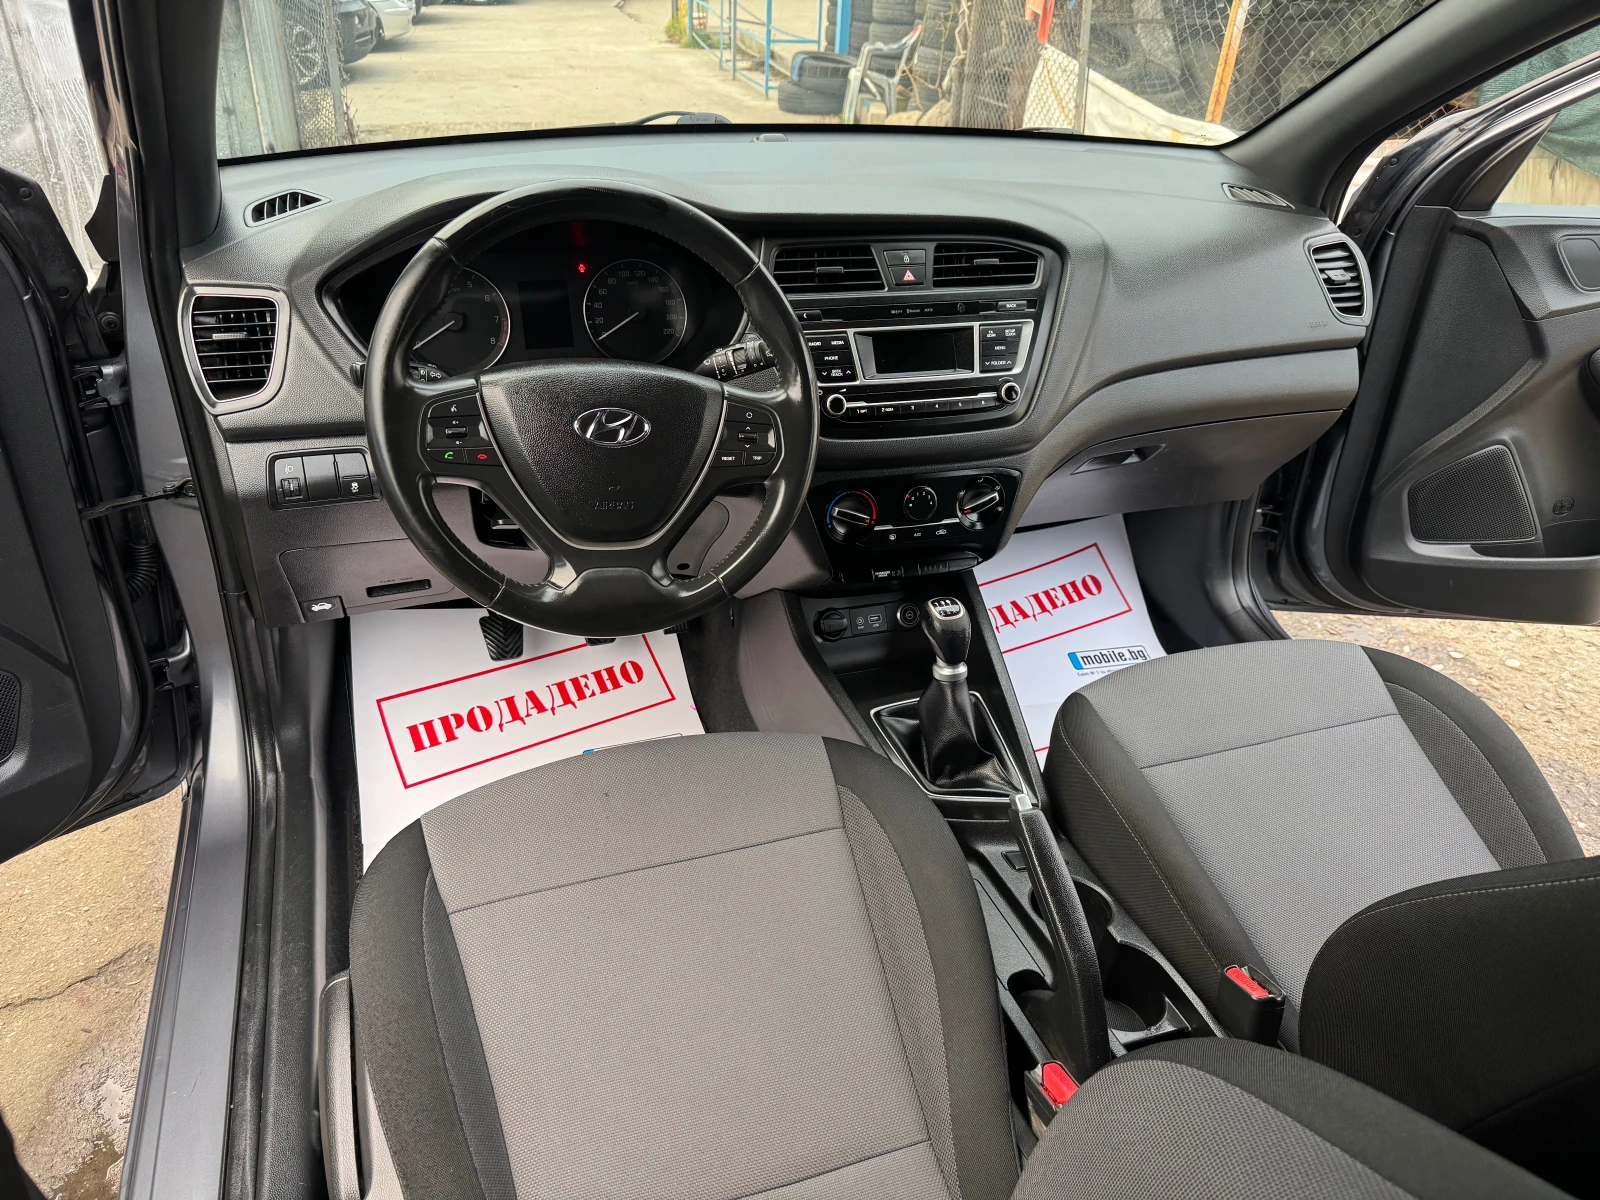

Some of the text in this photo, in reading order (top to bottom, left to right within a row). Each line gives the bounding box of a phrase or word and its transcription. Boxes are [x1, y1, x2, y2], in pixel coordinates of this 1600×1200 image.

[490, 337, 496, 345] 8
[988, 574, 1103, 634] ДАДЕНО
[1080, 649, 1148, 666] mobile.bg
[406, 660, 644, 753] ПРОДАДЕНО
